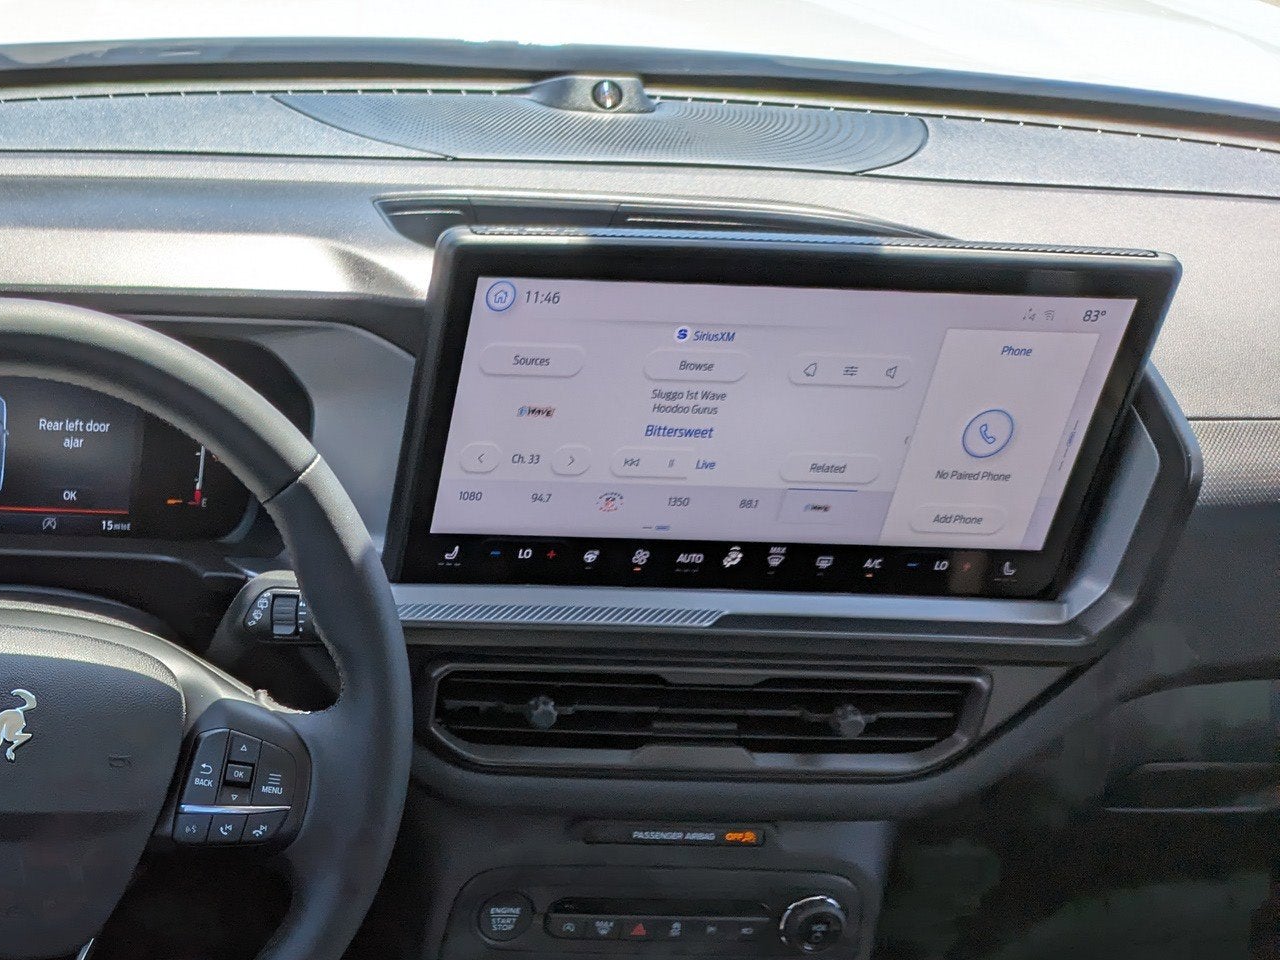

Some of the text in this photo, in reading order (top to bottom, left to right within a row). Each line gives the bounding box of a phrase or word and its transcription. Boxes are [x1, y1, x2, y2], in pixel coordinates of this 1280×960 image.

[525, 290, 560, 305] 11:46
[693, 330, 736, 343] SiriusXM
[1000, 345, 1033, 357] Phone
[512, 354, 551, 367] Sources
[679, 360, 715, 372] Browse
[651, 389, 683, 402] Sluggo
[700, 391, 727, 402] Wave
[652, 403, 718, 415] Hoodoo Gurus
[39, 419, 110, 433] Rear left door
[644, 424, 715, 440] Bittersweet
[63, 437, 83, 448] ajar
[511, 453, 540, 464] Ch. 33
[695, 459, 716, 470] Live
[809, 462, 847, 474] Related
[935, 470, 1011, 482] No Paired Phone
[63, 491, 76, 501] OK
[459, 490, 482, 501] 1080
[531, 492, 552, 503] 94.7
[667, 497, 690, 508] 1350
[739, 499, 758, 510] 88.1
[933, 514, 983, 526] Add Phone
[518, 549, 532, 559] LO
[676, 552, 704, 564] AUTO
[863, 558, 883, 569] A/C
[934, 561, 948, 571] LO
[194, 778, 213, 787] BACK
[261, 786, 283, 795] MENU
[632, 831, 682, 840] PASSENGER
[684, 832, 716, 840] AIRBAG
[490, 907, 521, 915] ENGINE
